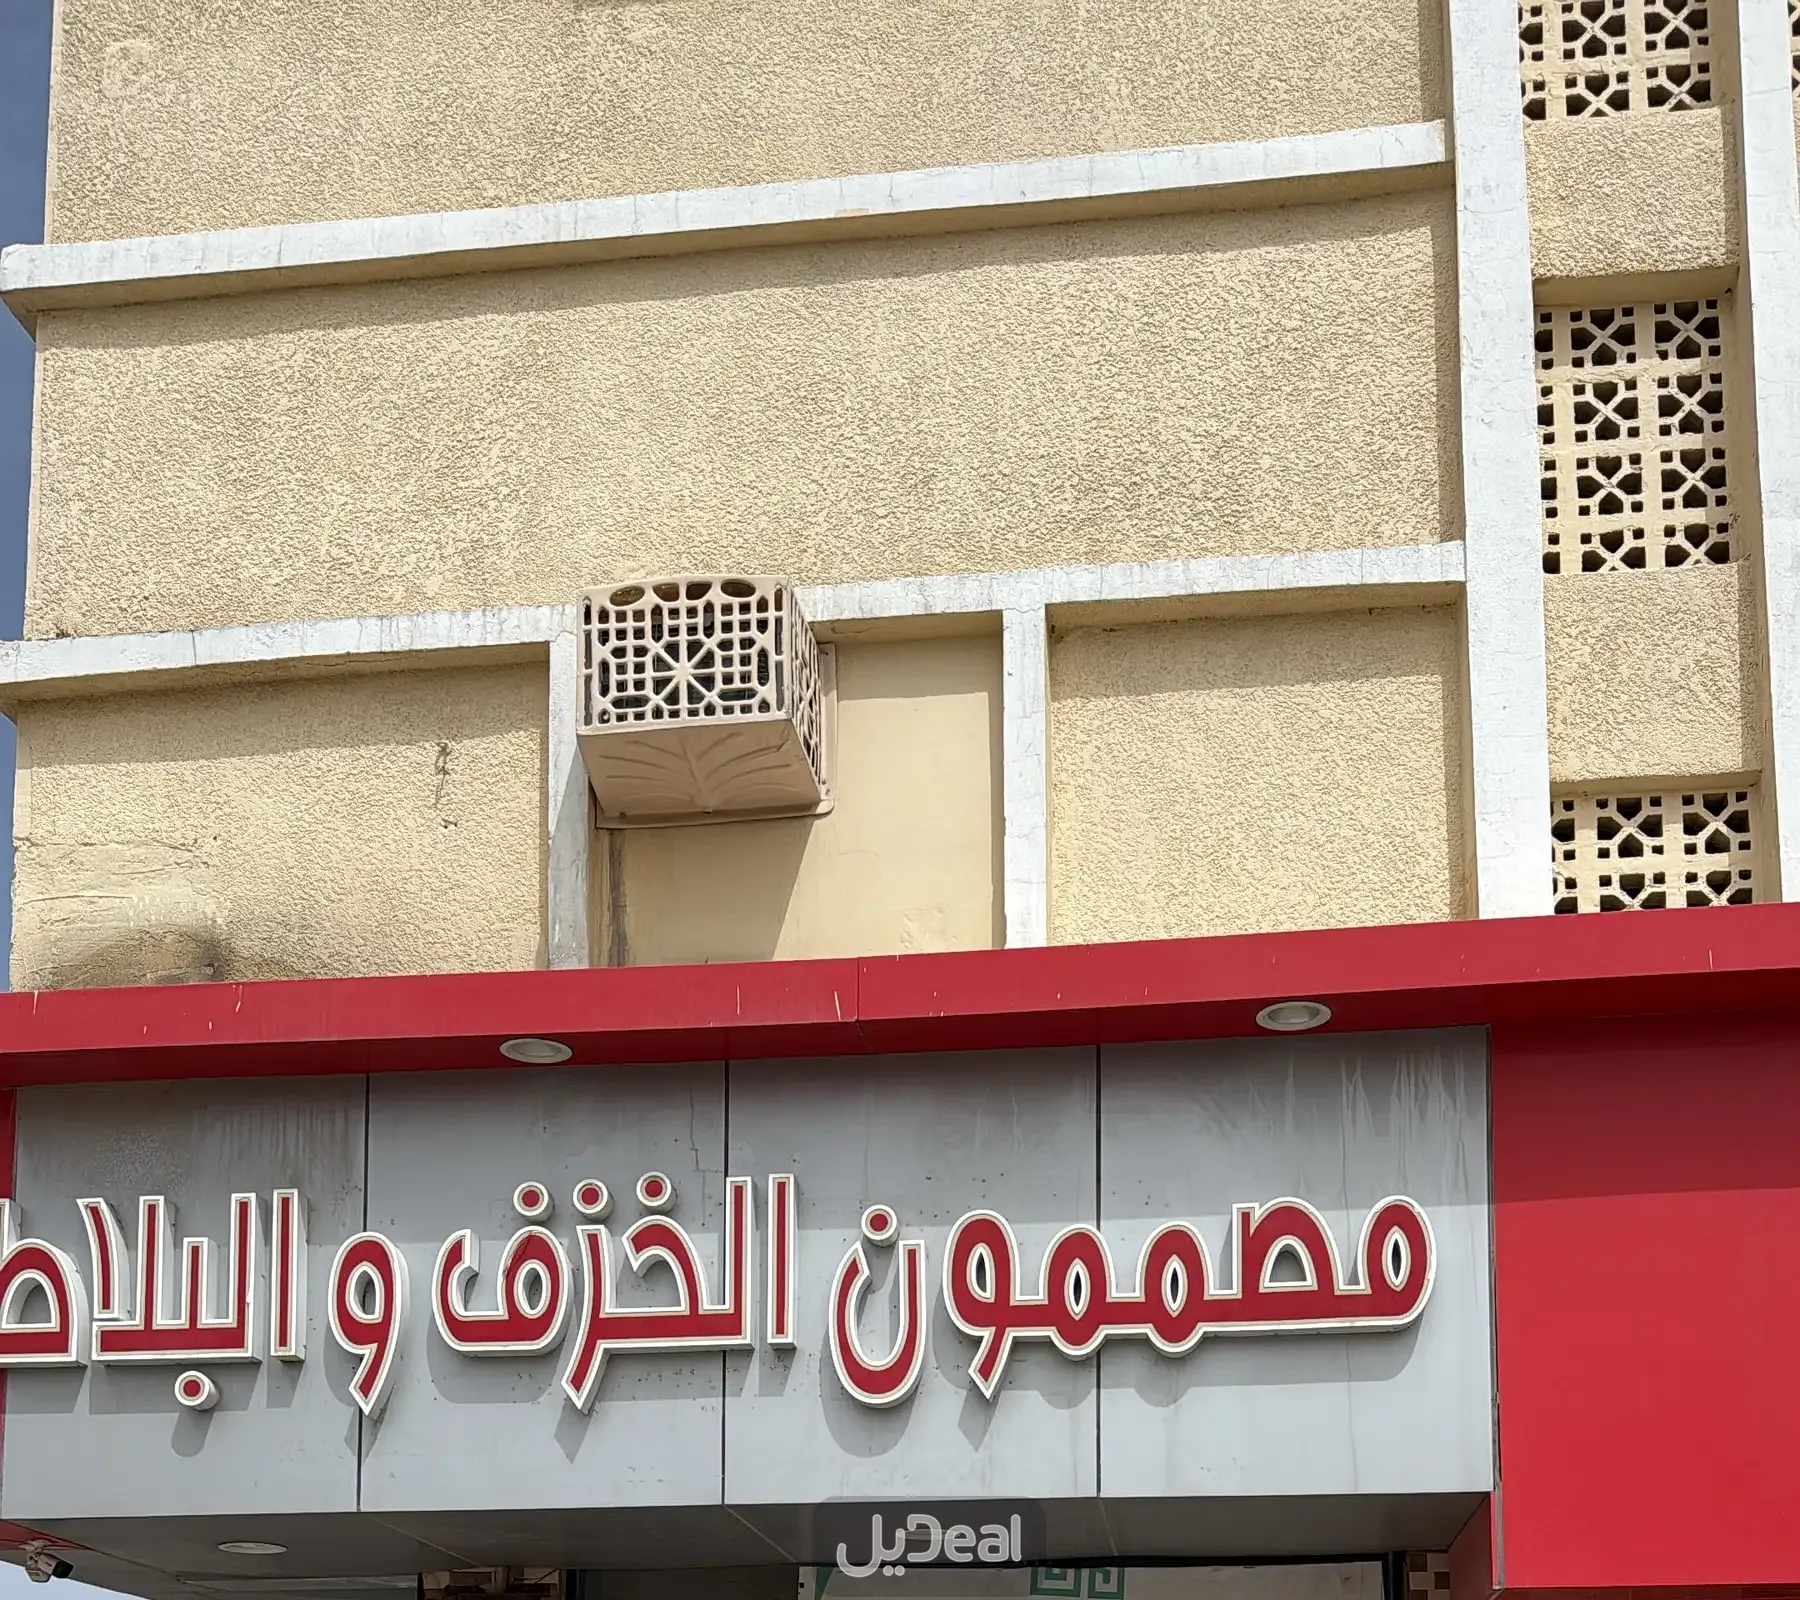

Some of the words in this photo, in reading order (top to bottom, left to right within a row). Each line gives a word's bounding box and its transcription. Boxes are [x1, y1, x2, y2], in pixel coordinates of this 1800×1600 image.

[328, 1231, 407, 1415] و
[431, 1172, 797, 1411] الخزف
[829, 1195, 1437, 1407] مصممون
